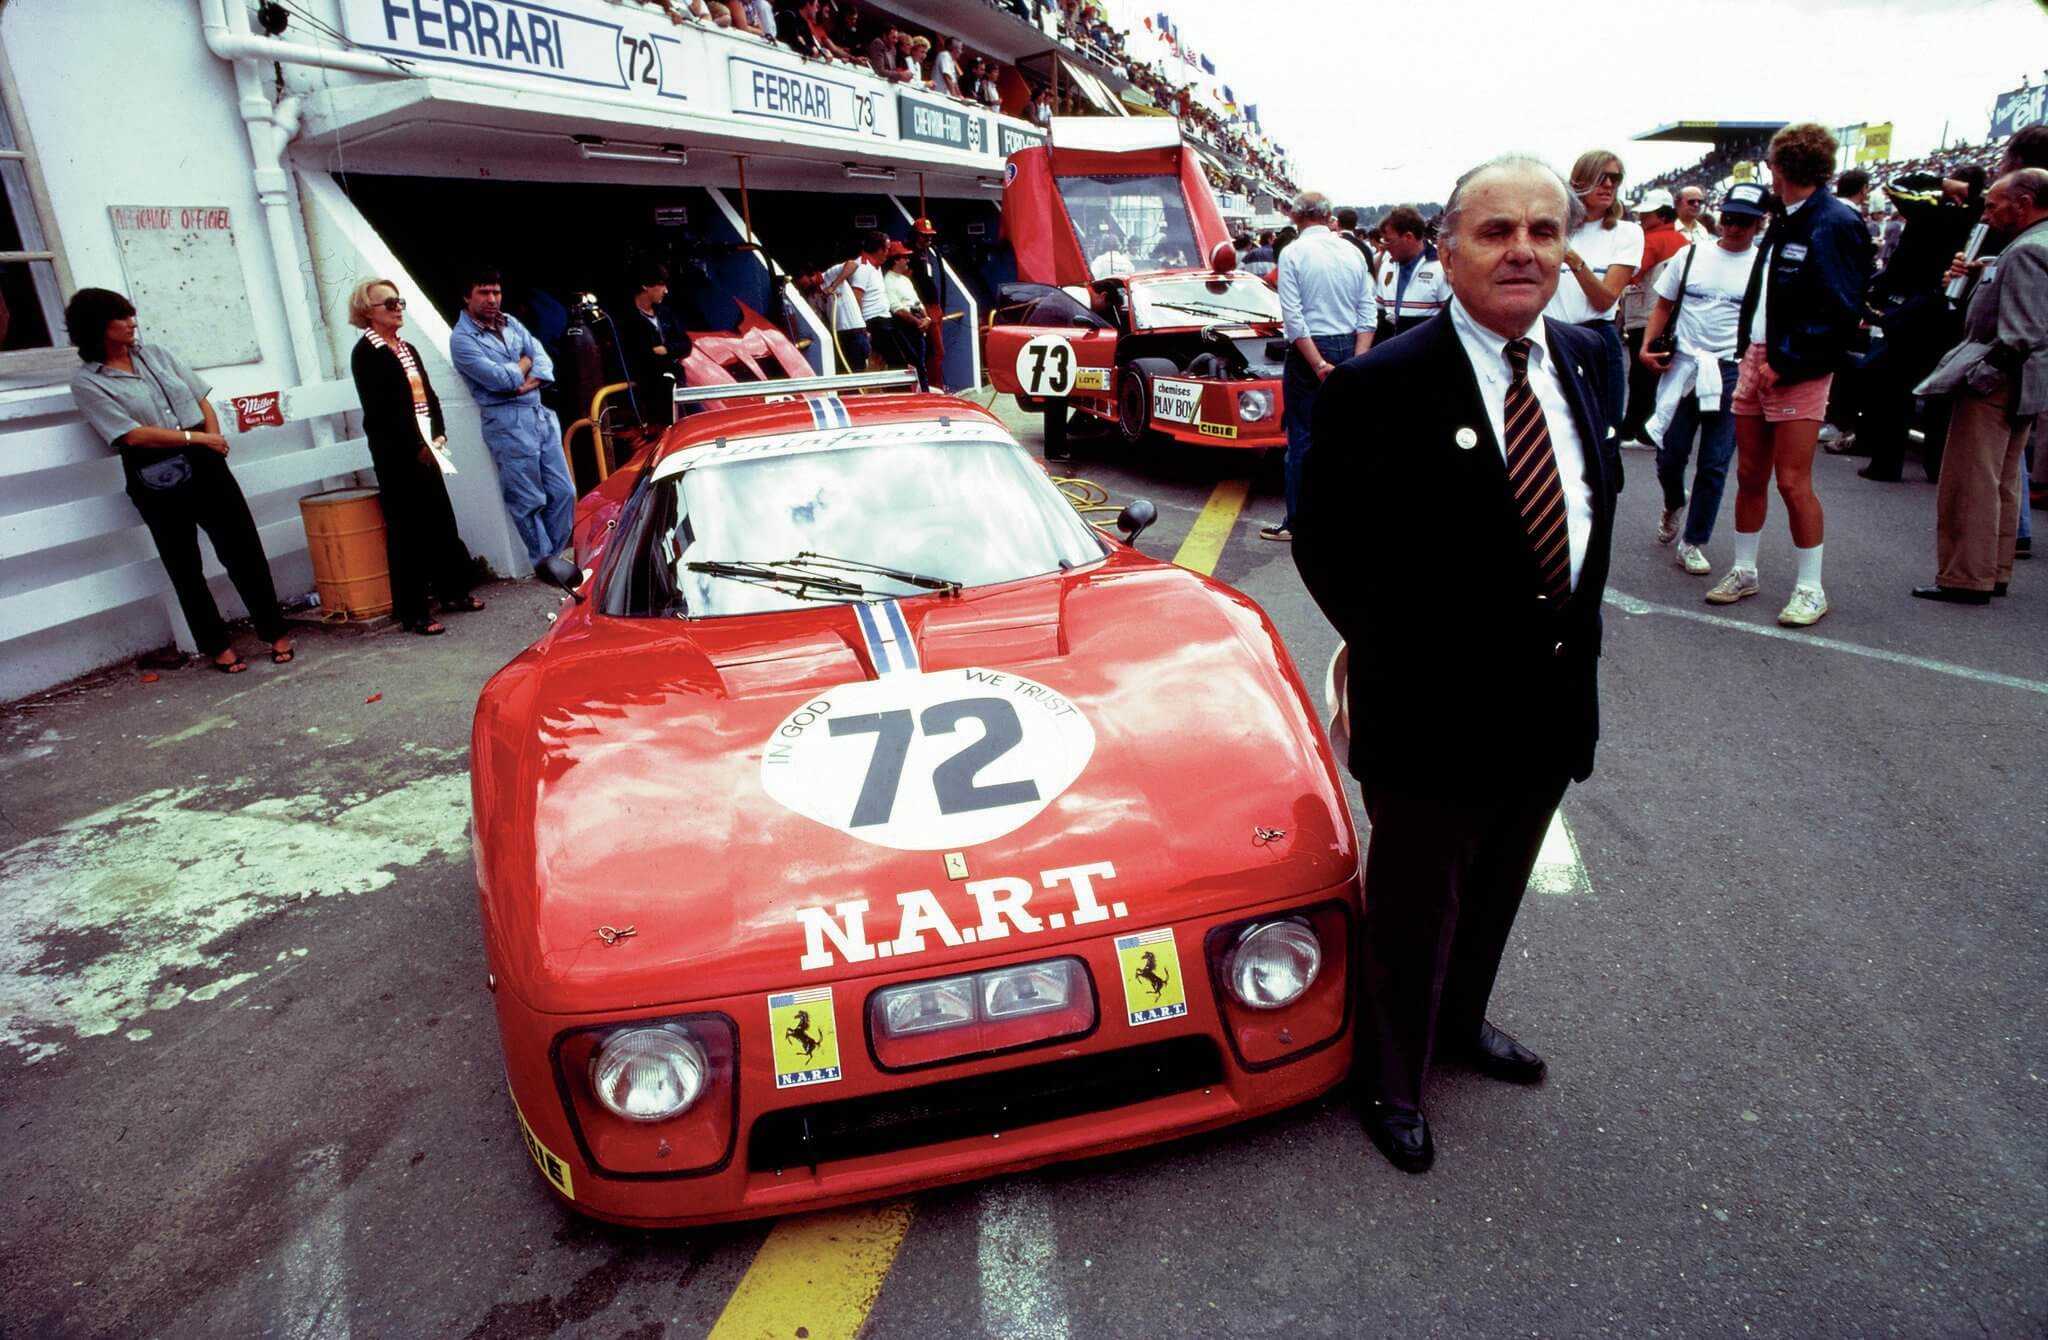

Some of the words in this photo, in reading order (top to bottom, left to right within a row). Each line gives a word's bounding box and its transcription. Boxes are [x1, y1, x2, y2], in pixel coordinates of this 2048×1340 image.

[383, 0, 563, 69] FERRARI
[623, 38, 658, 86] 72
[752, 70, 832, 120] FERRARI
[856, 95, 873, 128] 73
[969, 118, 980, 145] 55
[1028, 345, 1069, 393] 73
[237, 398, 275, 415] Miller
[1154, 396, 1175, 415] PLAY
[1175, 399, 1195, 419] BOY
[1158, 384, 1192, 397] chemises
[1201, 424, 1234, 436] CIBIE
[964, 669, 1004, 687] WE
[1013, 680, 1078, 717] TRUST
[767, 743, 792, 764] IN
[780, 700, 832, 739] GOD
[828, 697, 1041, 828] 72
[796, 861, 1129, 971] N.A.R.T.
[1134, 1004, 1184, 1023] N.A.R.T.
[782, 1068, 838, 1085] N.A.R.T.
